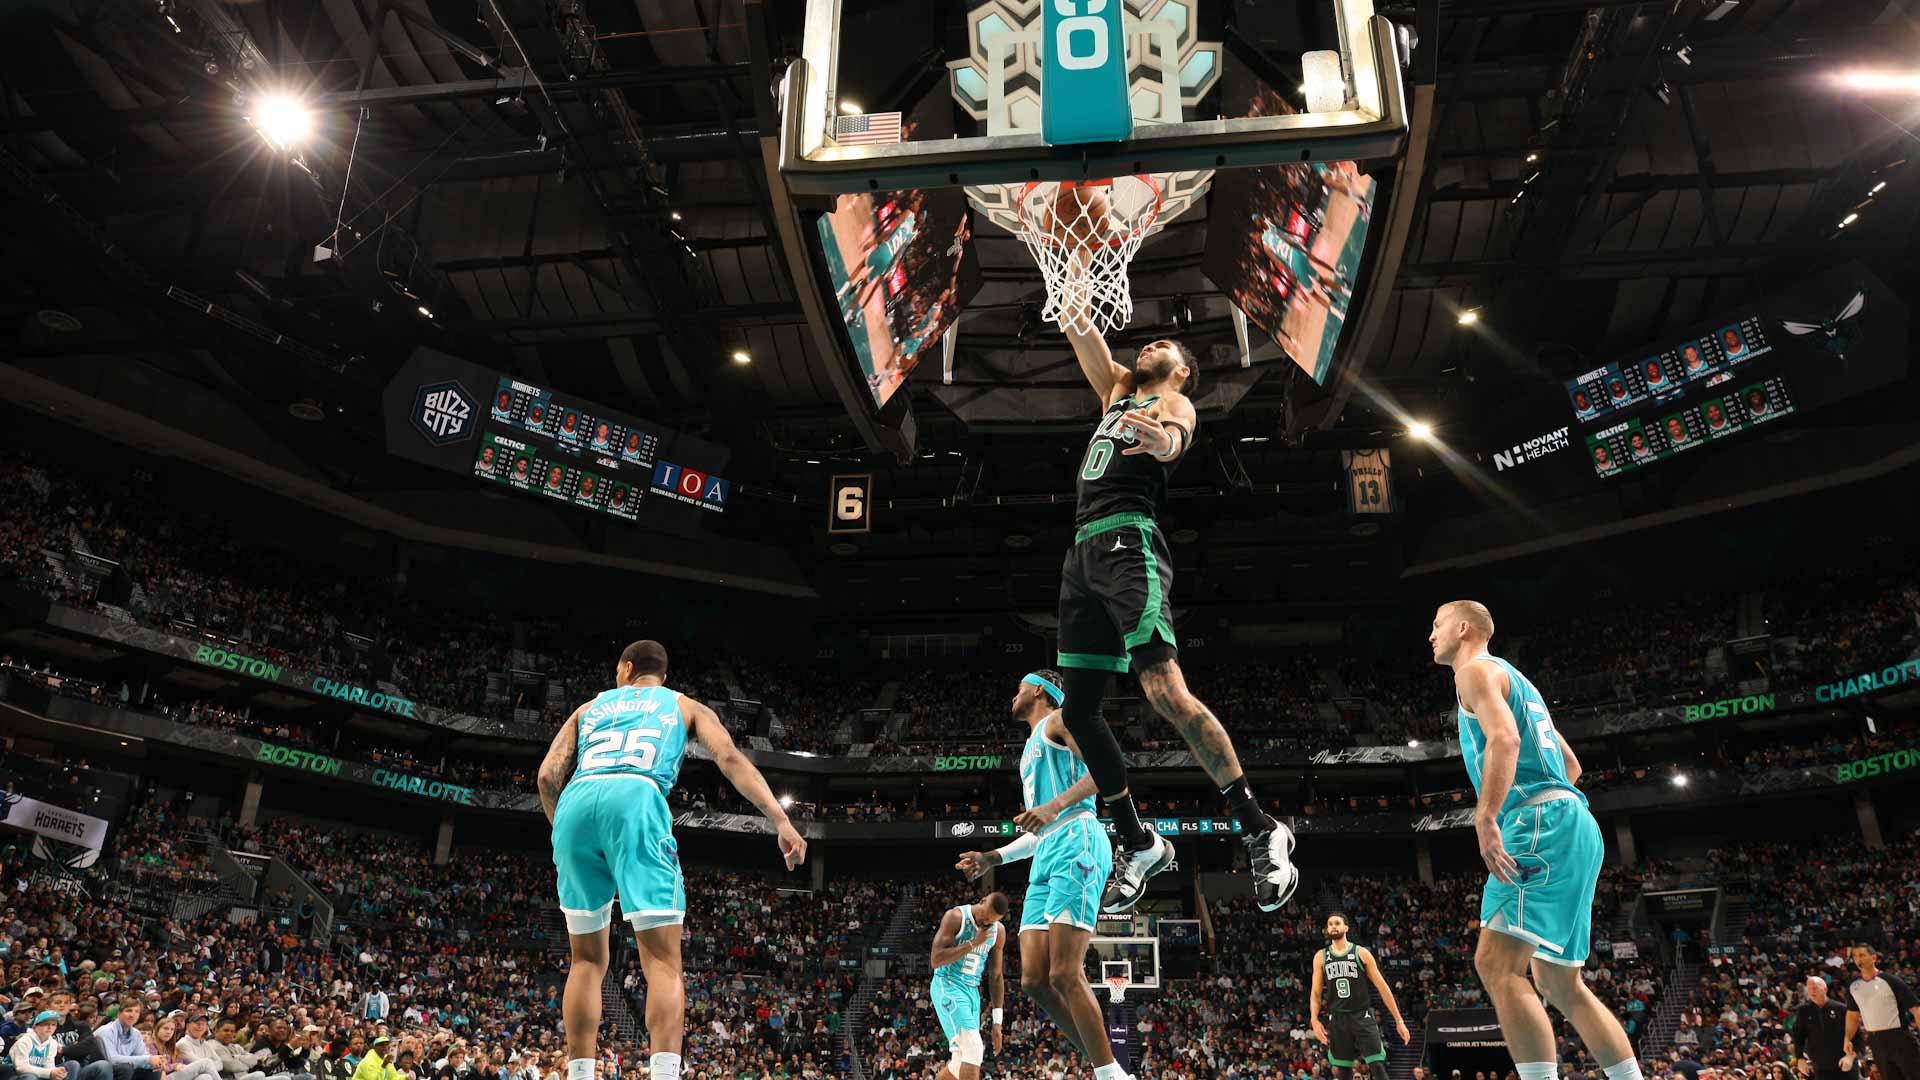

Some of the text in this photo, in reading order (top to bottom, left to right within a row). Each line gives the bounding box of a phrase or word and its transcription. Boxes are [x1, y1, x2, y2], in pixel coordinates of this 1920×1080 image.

[511, 380, 541, 397] HORNETS
[1576, 366, 1609, 386] HORNETS
[424, 389, 471, 420] BUZZ
[422, 408, 463, 437] CITY
[1595, 421, 1629, 440] CELTICS
[494, 435, 526, 451] CELTICS
[1522, 426, 1569, 452] NOVANT
[1525, 438, 1570, 461] HEALTH
[1082, 439, 1114, 480] 0
[660, 464, 723, 503] IOA
[1359, 480, 1381, 505] 13
[650, 486, 678, 500] INSURANCE
[678, 494, 695, 505] OFFICE
[702, 502, 723, 513] AMERICA
[837, 487, 864, 521] 6
[195, 645, 283, 682] BOSTON
[312, 676, 417, 720] CHARLOTTE
[580, 699, 661, 736] WASHINGTON
[1685, 692, 1776, 721] BOSTON
[581, 728, 661, 770] 25
[935, 755, 1002, 770] BOSTON
[1837, 749, 1920, 784] BOSTON
[256, 743, 344, 777] BOSTON
[371, 768, 474, 808] CHARLOTTE
[34, 811, 85, 838] HORNETS
[983, 825, 1028, 833] TOL 5 FL
[1157, 821, 1242, 831] CHA FLS 3 TOL 5
[962, 952, 980, 977] 3
[1325, 961, 1358, 980] CELTICS
[1335, 978, 1351, 998] 9
[1437, 1024, 1500, 1033] GEIC
[1480, 1040, 1506, 1048] TRANSPO
